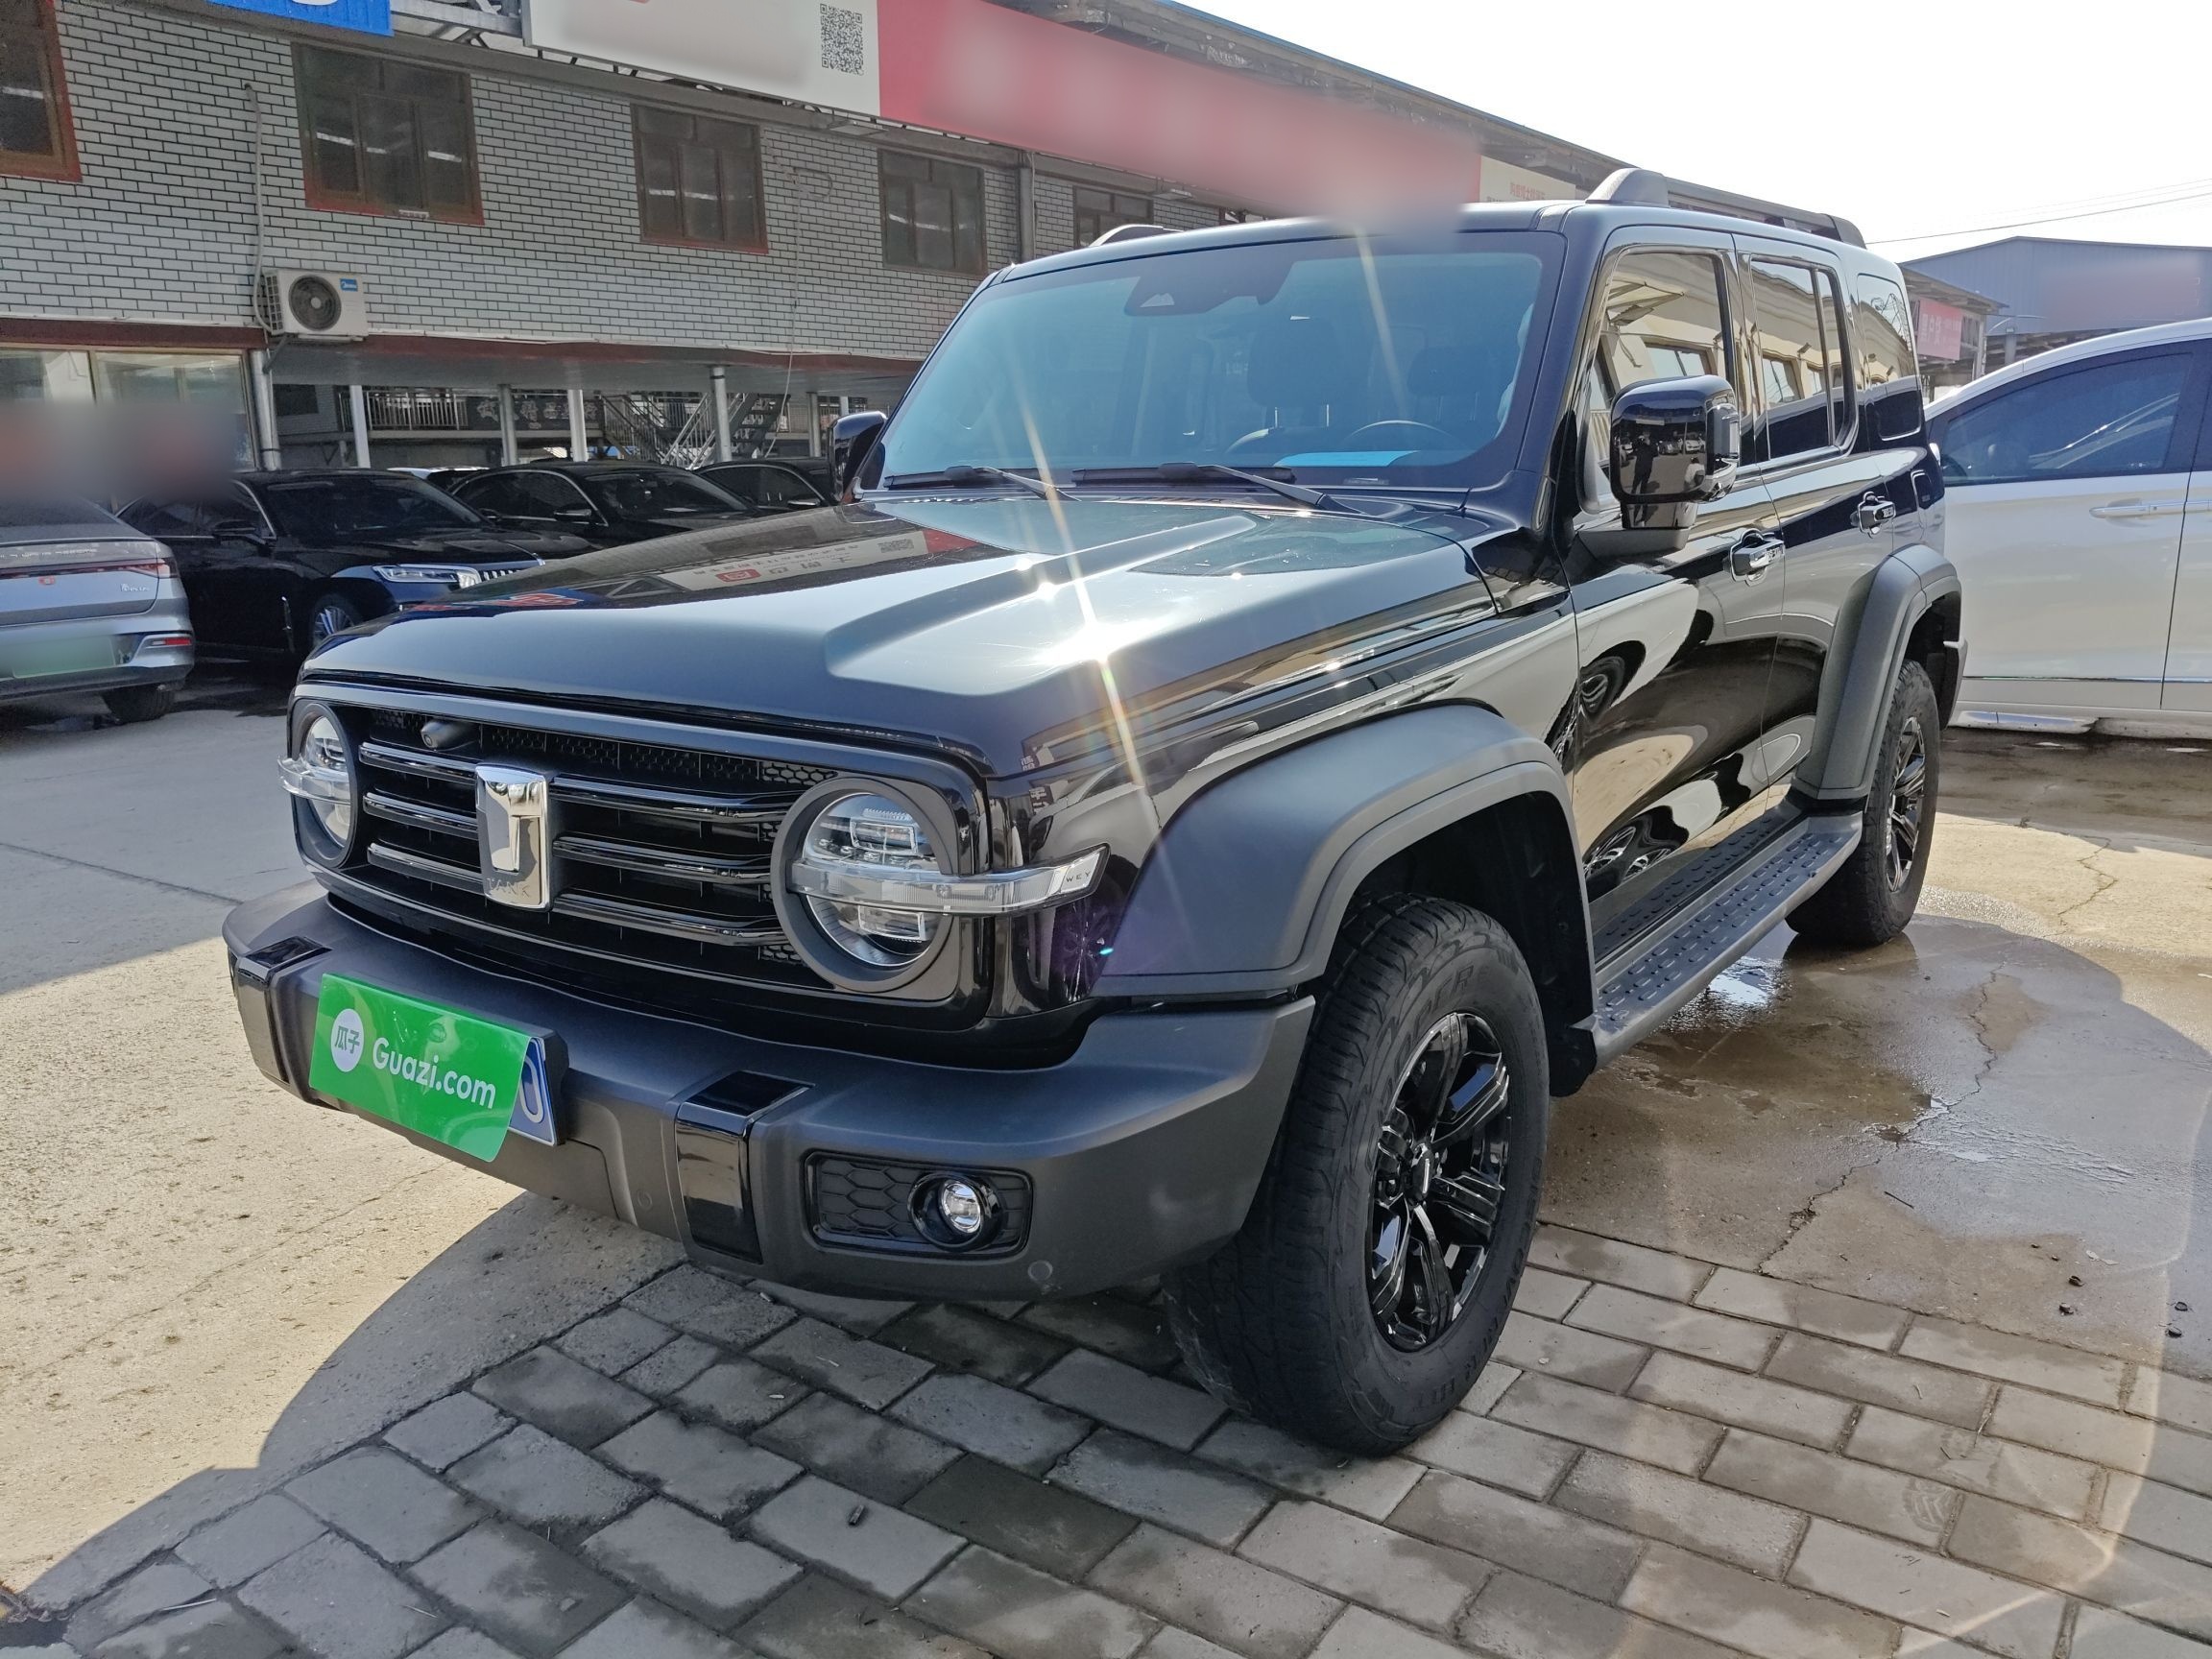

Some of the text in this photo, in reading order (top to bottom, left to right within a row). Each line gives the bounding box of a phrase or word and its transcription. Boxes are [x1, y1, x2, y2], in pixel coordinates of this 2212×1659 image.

[486, 878, 531, 899] TANK
[1066, 871, 1091, 882] WEY
[334, 1025, 361, 1055] 瓜子
[373, 1037, 496, 1110] Guazi.com
